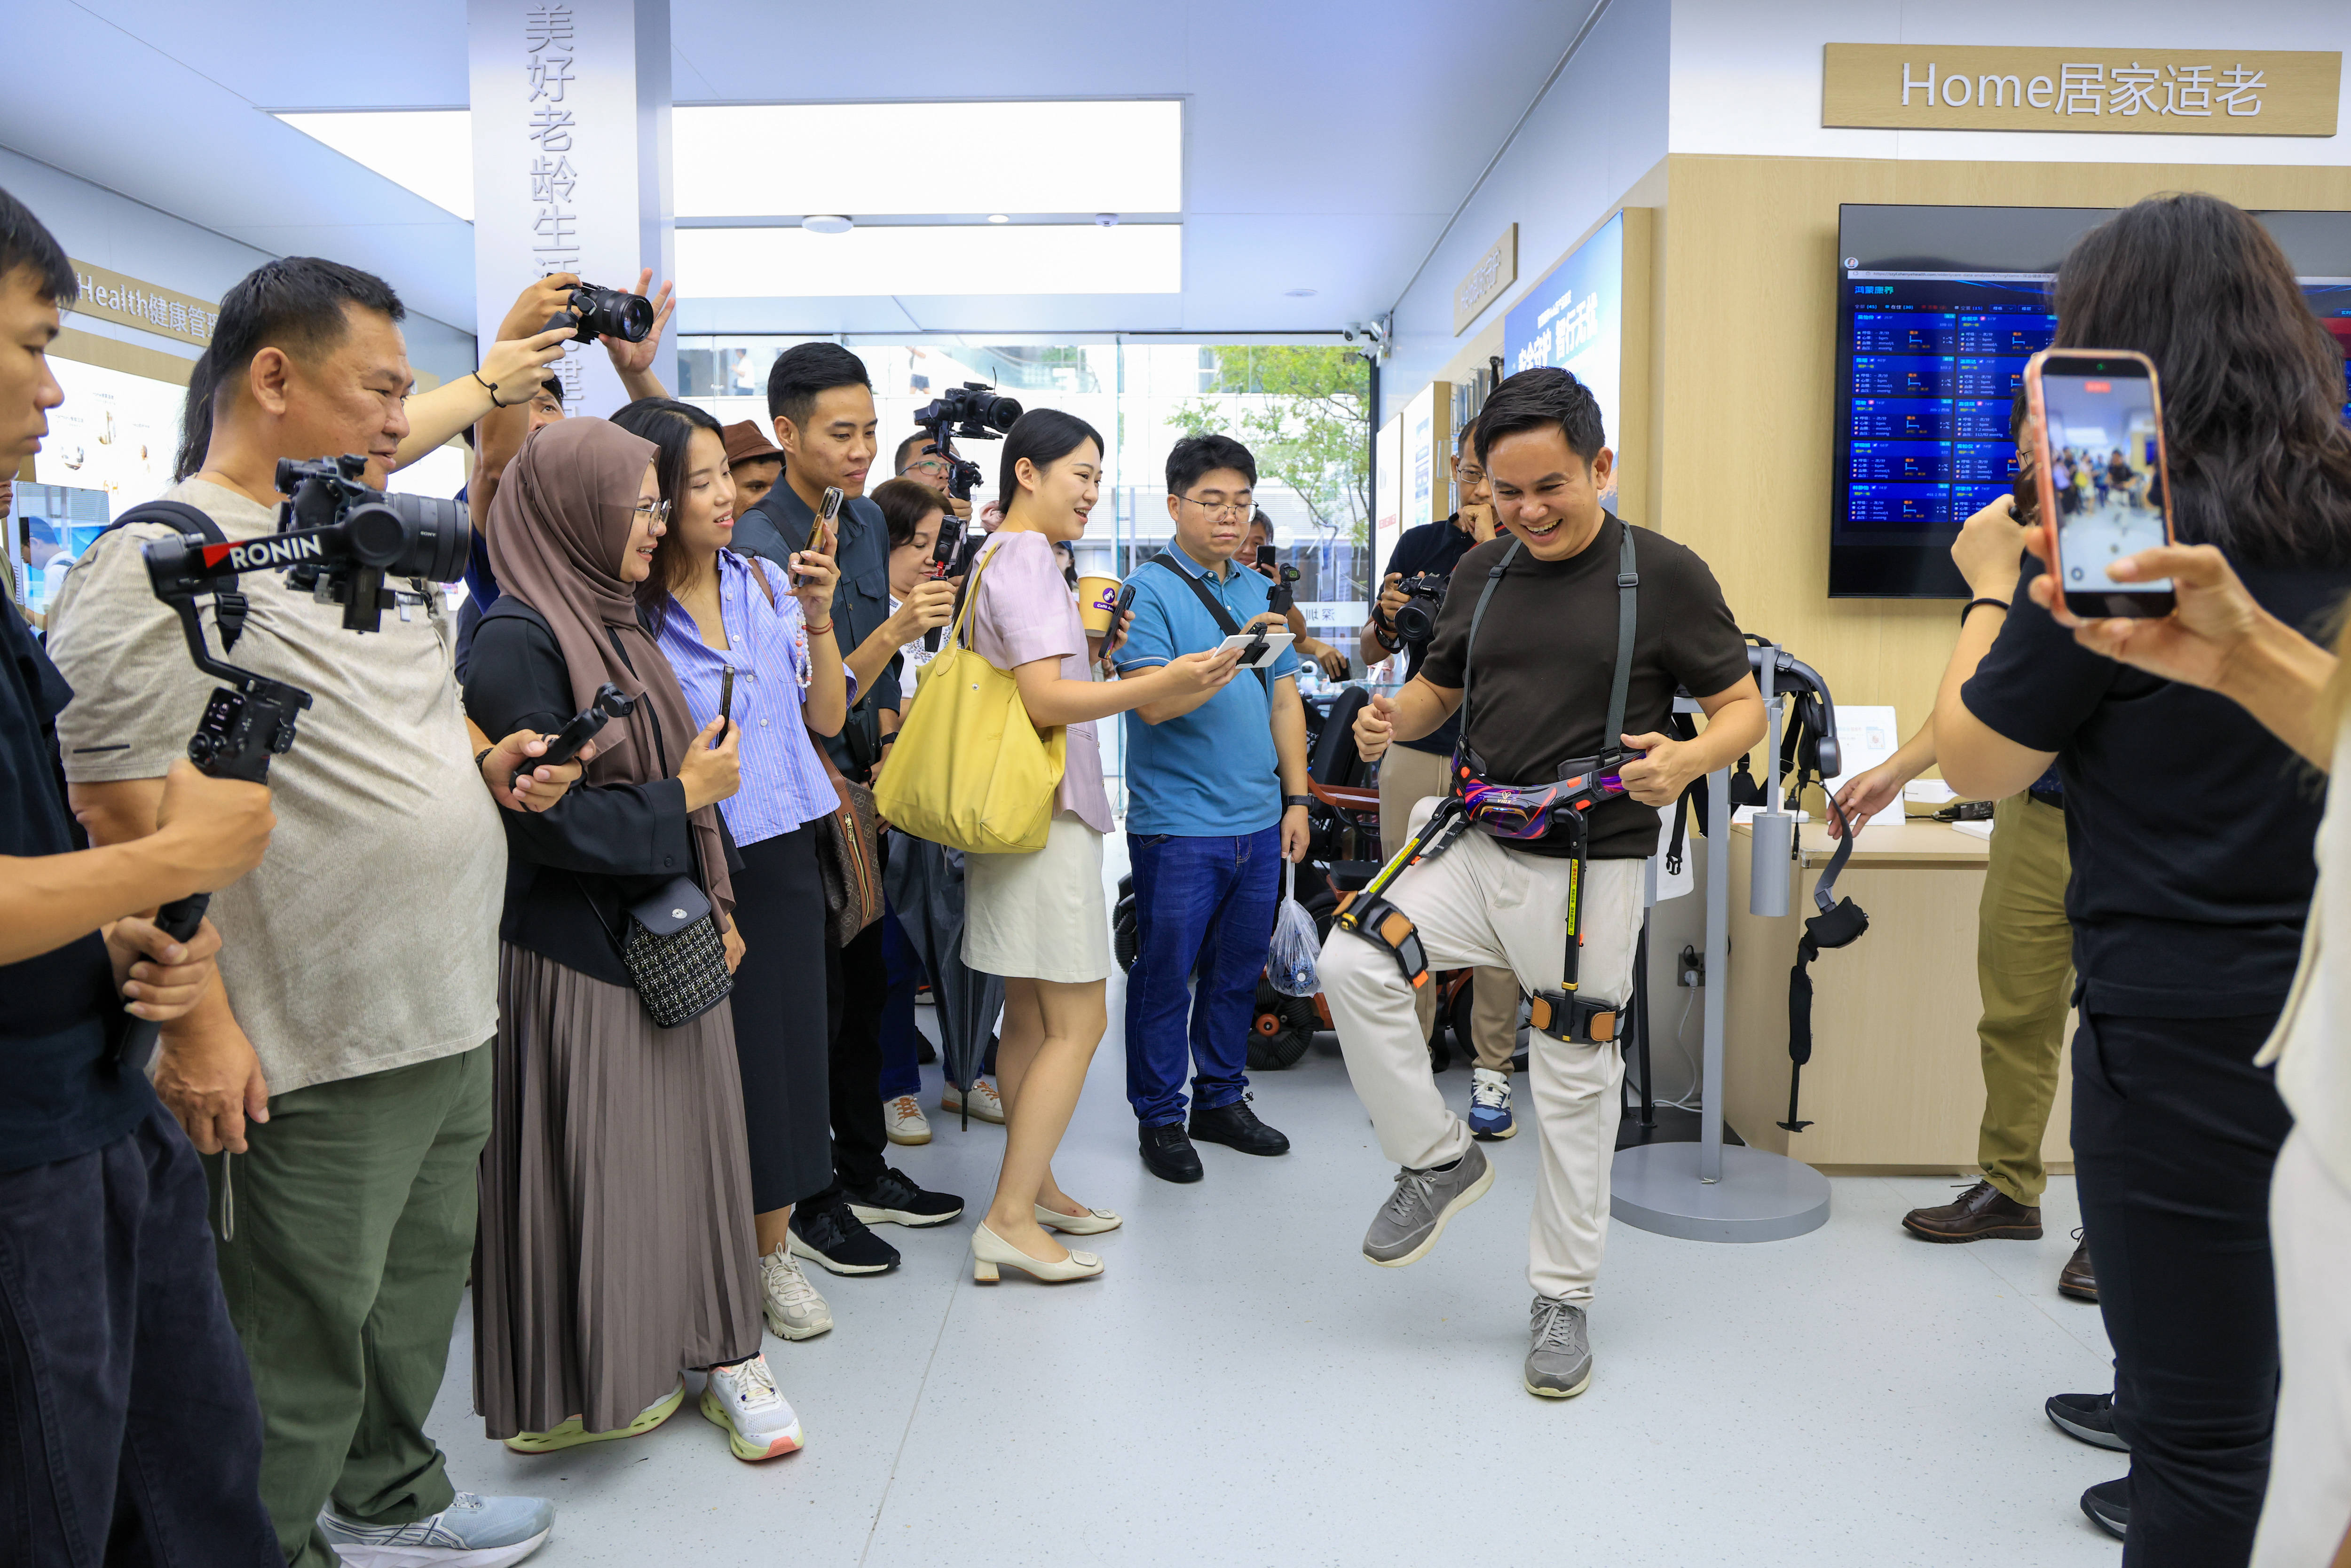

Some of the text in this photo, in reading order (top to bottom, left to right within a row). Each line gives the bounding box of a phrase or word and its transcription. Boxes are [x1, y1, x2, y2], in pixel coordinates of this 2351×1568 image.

[1901, 62, 2267, 117] Home居家适老
[1854, 286, 1894, 294] 鸿蒙康养
[229, 534, 323, 569] RONIN
